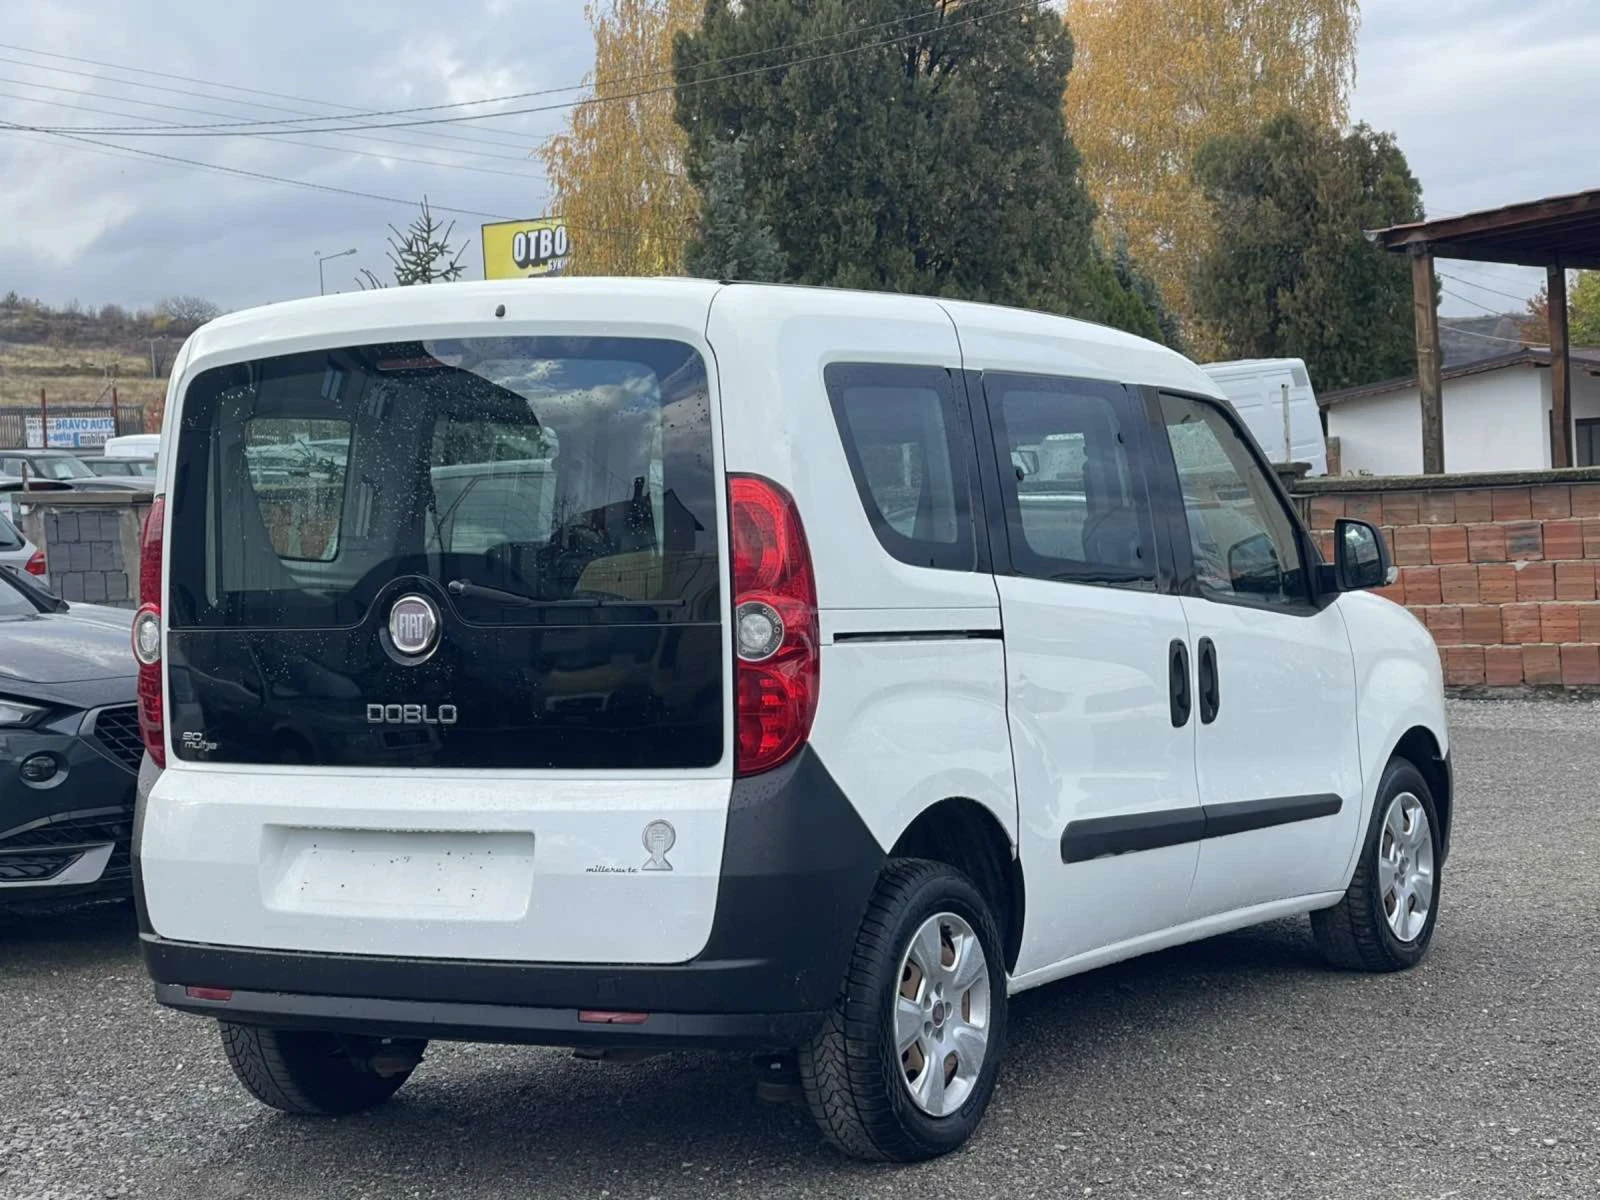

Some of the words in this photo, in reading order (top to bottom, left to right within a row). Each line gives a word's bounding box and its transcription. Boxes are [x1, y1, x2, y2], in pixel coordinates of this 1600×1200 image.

[56, 419, 88, 430] BRAVO
[400, 613, 425, 639] FIAT
[367, 703, 457, 724] DOBLO
